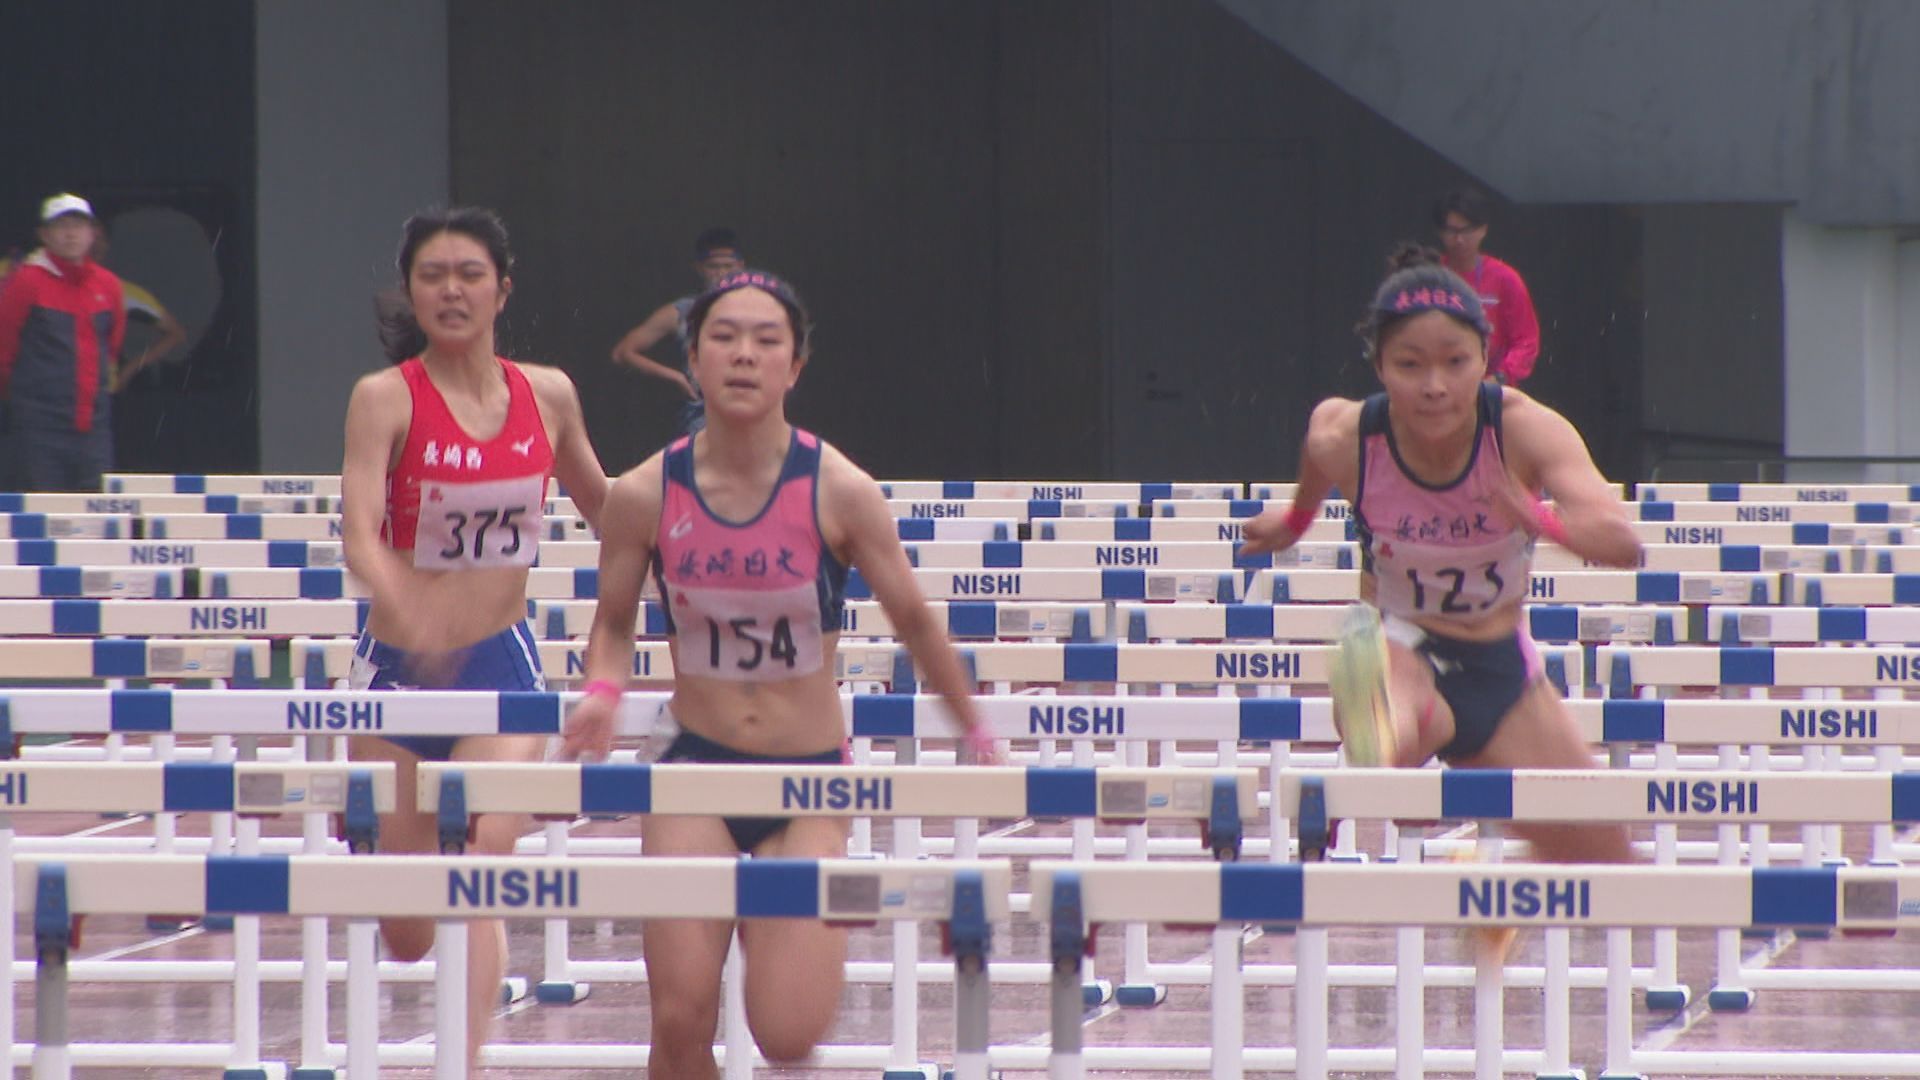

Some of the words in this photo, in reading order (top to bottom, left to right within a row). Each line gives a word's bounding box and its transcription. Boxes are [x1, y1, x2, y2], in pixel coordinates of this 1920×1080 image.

[262, 480, 314, 495] NISHI
[1033, 486, 1083, 500] NISHI
[1797, 490, 1848, 501] NISHI
[87, 499, 140, 514] NISHI
[912, 503, 965, 519] NISHI
[1736, 506, 1791, 522] NISHI
[440, 505, 526, 560] 375
[1665, 527, 1723, 544] NISHI
[131, 545, 194, 565] NISHI
[1096, 546, 1158, 566] NISHI
[952, 574, 1021, 595] NISHI
[1406, 560, 1505, 614] 123
[191, 607, 267, 630] NISHI
[705, 615, 798, 671] 154
[1216, 652, 1300, 678] NISHI
[287, 701, 383, 730] NISHI
[1029, 706, 1125, 735] NISHI
[1780, 709, 1877, 738] NISHI
[783, 777, 893, 810] NISHI
[1647, 780, 1758, 814] NISHI
[448, 869, 579, 908] NISHI
[1458, 878, 1590, 918] NISHI
